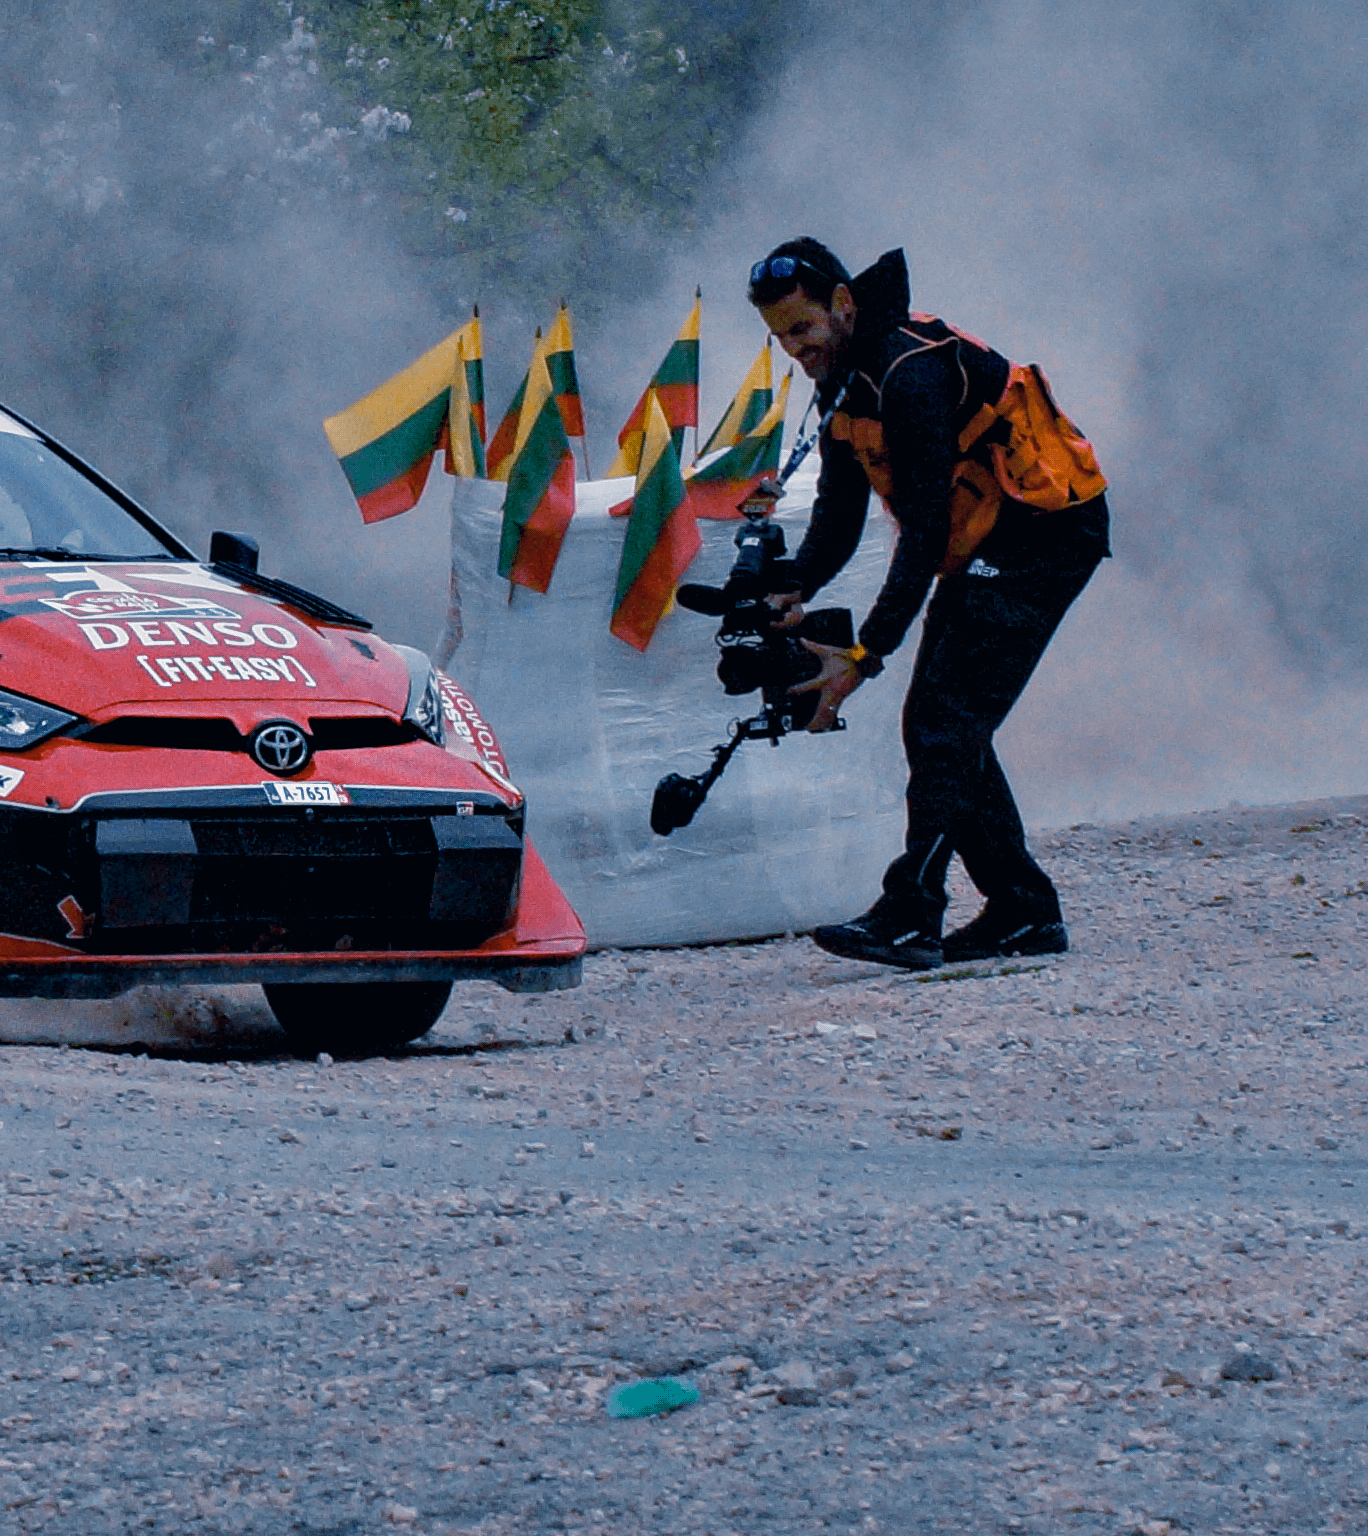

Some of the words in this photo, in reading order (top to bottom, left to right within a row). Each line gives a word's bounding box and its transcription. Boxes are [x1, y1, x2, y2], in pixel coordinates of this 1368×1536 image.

[77, 620, 298, 650] DENSO
[436, 669, 504, 775] UTOMOTIV
[283, 786, 331, 801] A-7657
